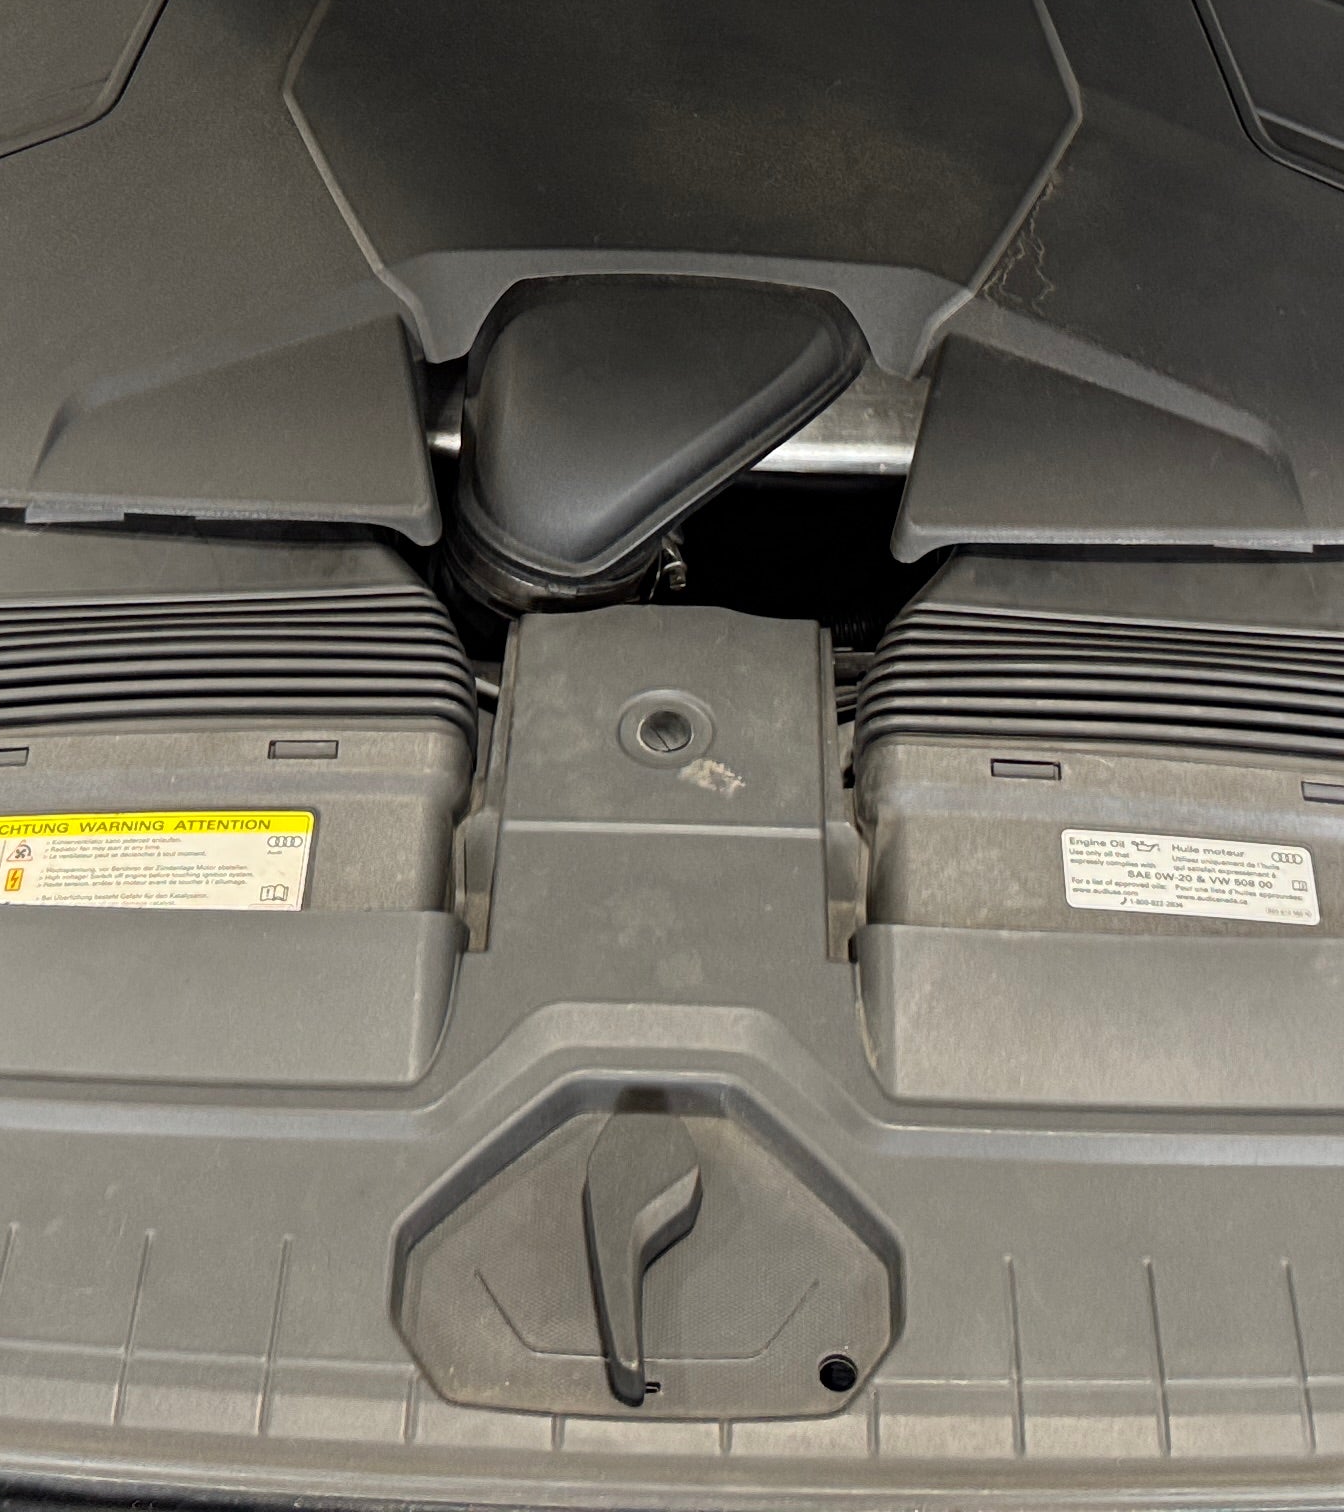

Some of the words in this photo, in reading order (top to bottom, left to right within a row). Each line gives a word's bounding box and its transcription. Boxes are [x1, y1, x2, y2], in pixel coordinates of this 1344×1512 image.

[79, 819, 164, 833] WARNING
[174, 819, 271, 832] ATTENTION
[1069, 837, 1106, 847] Engine
[1110, 840, 1125, 848] Oil
[1172, 844, 1200, 853] Huile
[1203, 846, 1244, 857] moteur
[1128, 870, 1151, 879] SAE
[1155, 872, 1193, 882] 0W-20
[1196, 875, 1205, 883] &
[1209, 876, 1230, 885] VW
[1234, 878, 1255, 887] 508
[1258, 880, 1273, 888] 00
